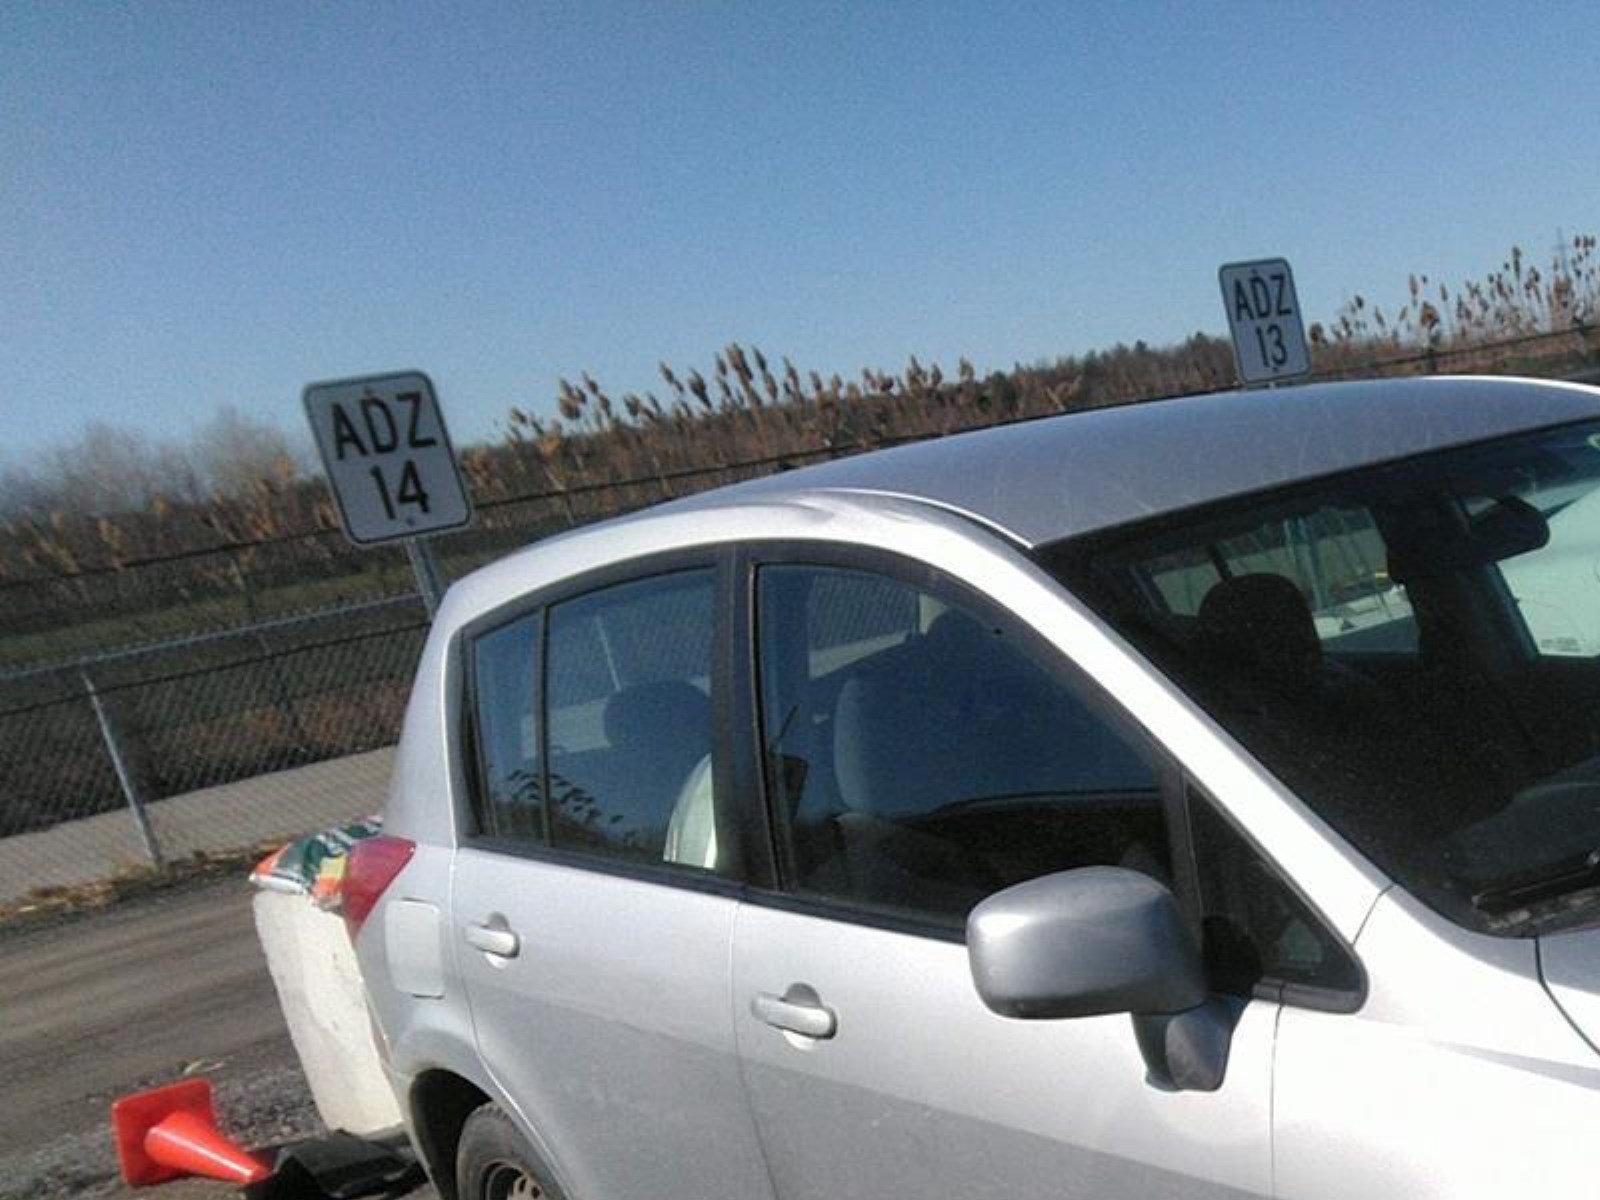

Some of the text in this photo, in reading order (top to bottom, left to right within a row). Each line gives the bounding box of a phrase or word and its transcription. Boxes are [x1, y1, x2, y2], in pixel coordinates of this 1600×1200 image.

[1234, 273, 1292, 322] ADZ
[1255, 323, 1287, 368] 13
[331, 391, 436, 460] ADZ
[370, 460, 430, 520] 14
